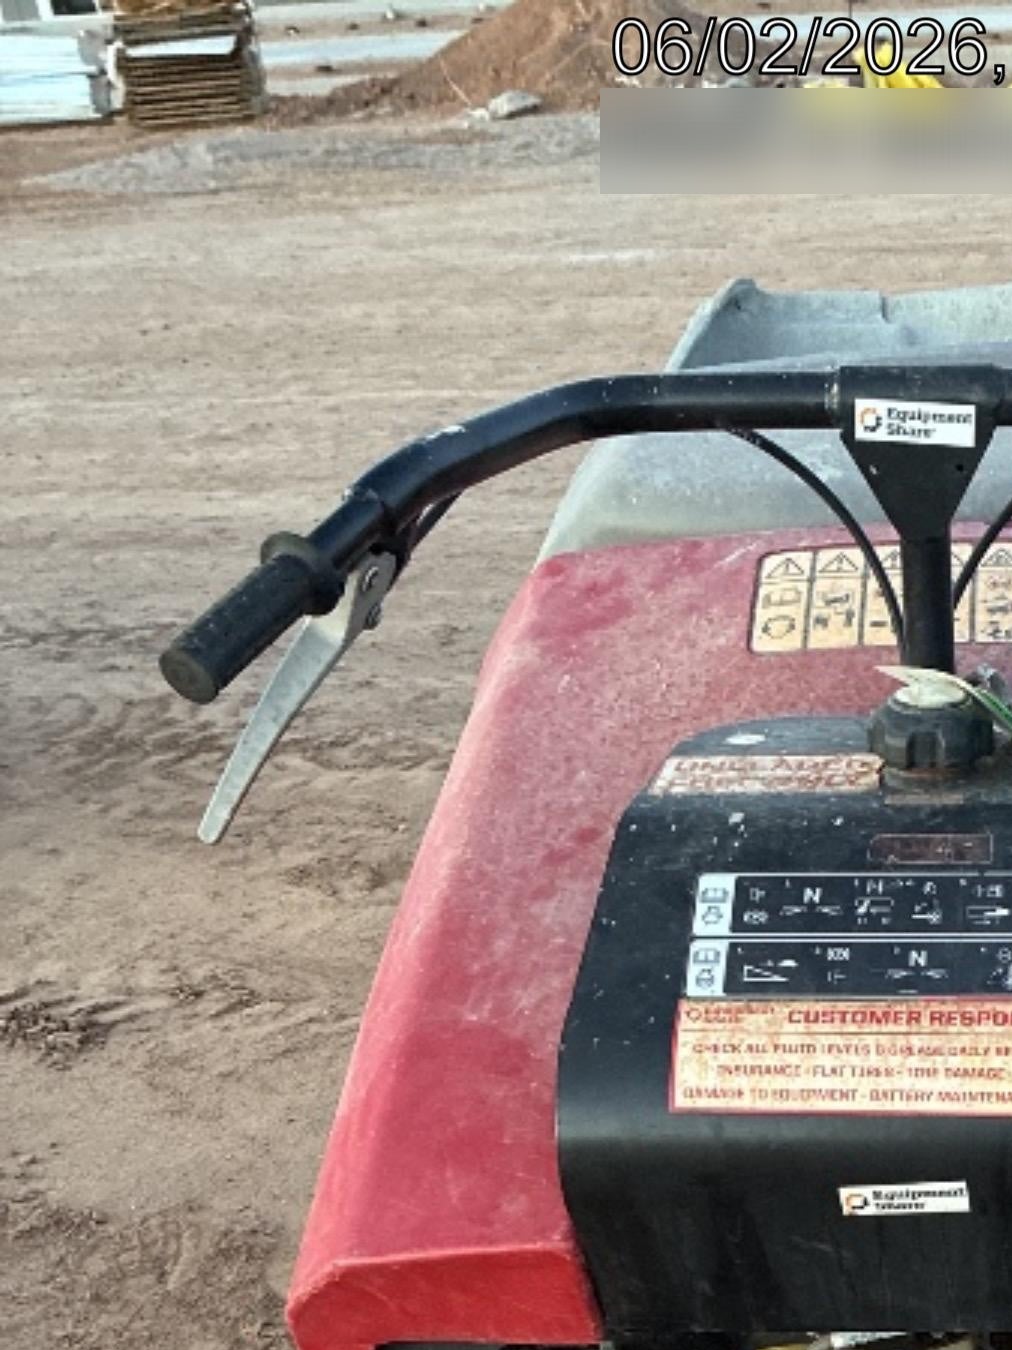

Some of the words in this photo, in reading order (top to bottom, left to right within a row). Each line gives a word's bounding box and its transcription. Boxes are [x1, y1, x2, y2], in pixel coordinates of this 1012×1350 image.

[887, 407, 973, 424] Equipment
[788, 1009, 921, 1026] CUSTOMER
[812, 1065, 845, 1078] FLAT
